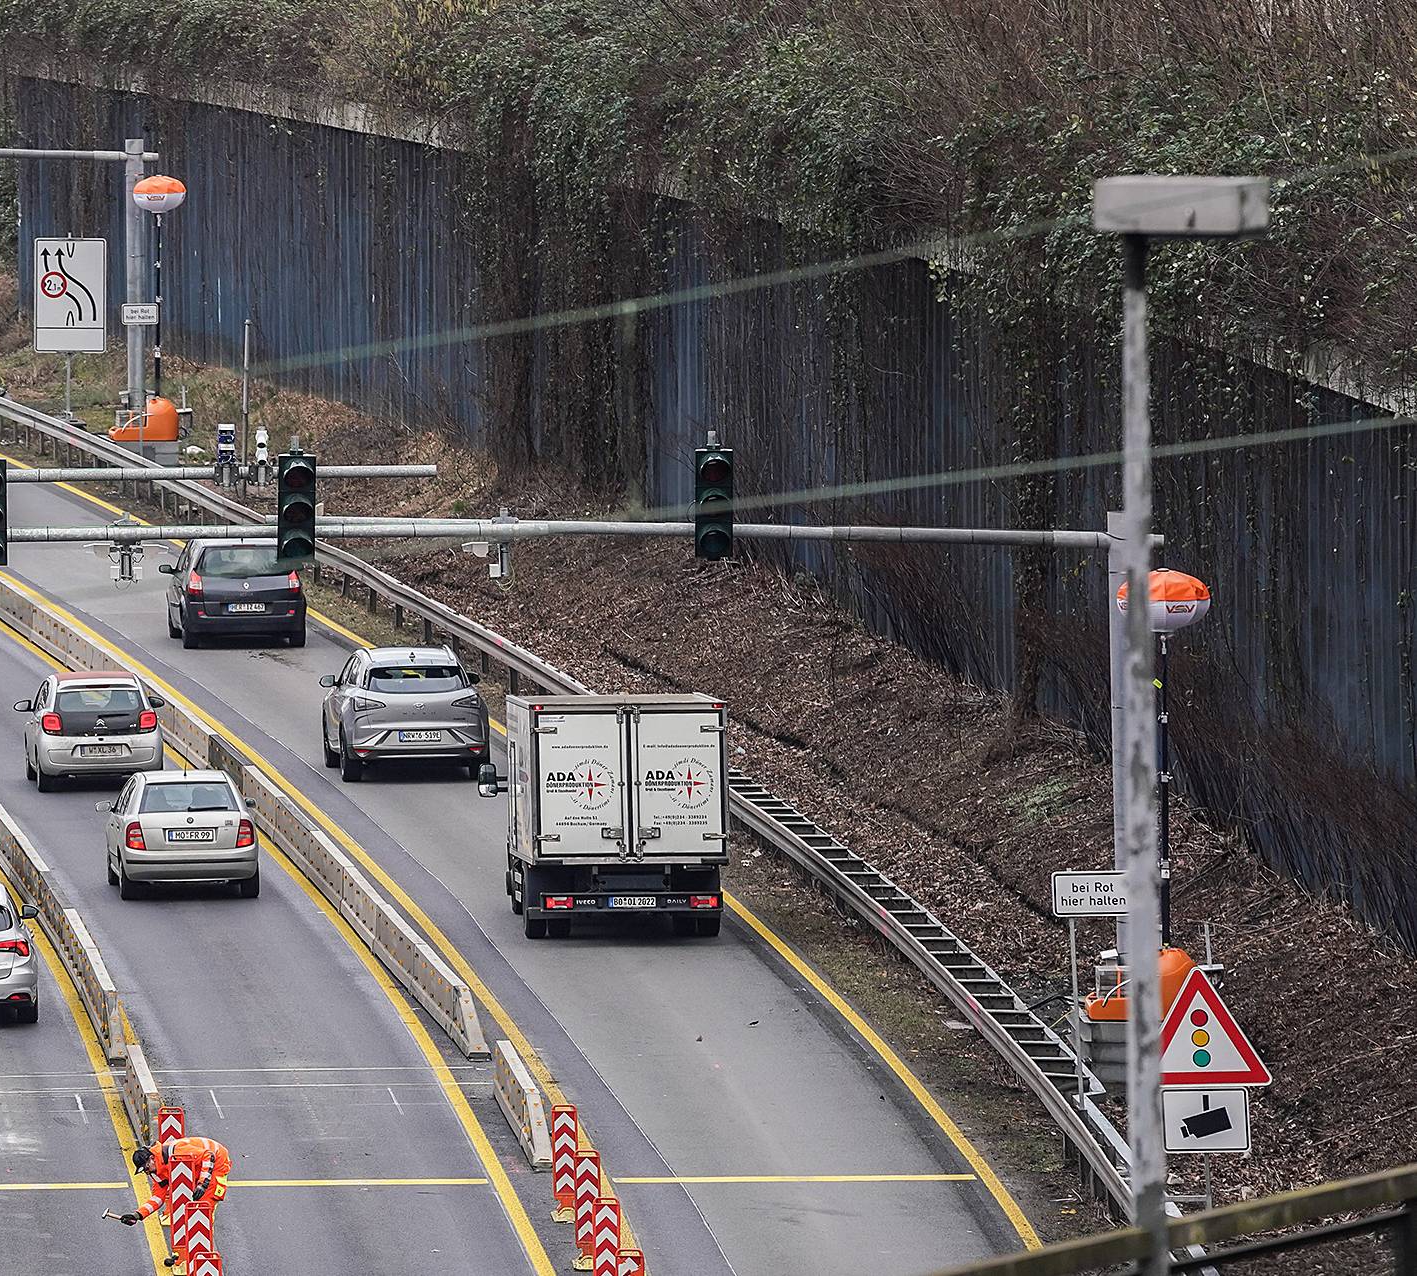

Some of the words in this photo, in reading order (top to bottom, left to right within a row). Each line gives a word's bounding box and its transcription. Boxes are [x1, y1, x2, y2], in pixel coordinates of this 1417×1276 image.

[1165, 604, 1195, 613] VSV
[546, 772, 576, 782] ADA
[645, 770, 675, 781] ADA
[1072, 882, 1089, 892] bei
[1094, 882, 1114, 892] Rot
[1061, 896, 1084, 906] hier
[1089, 895, 1127, 906] halten
